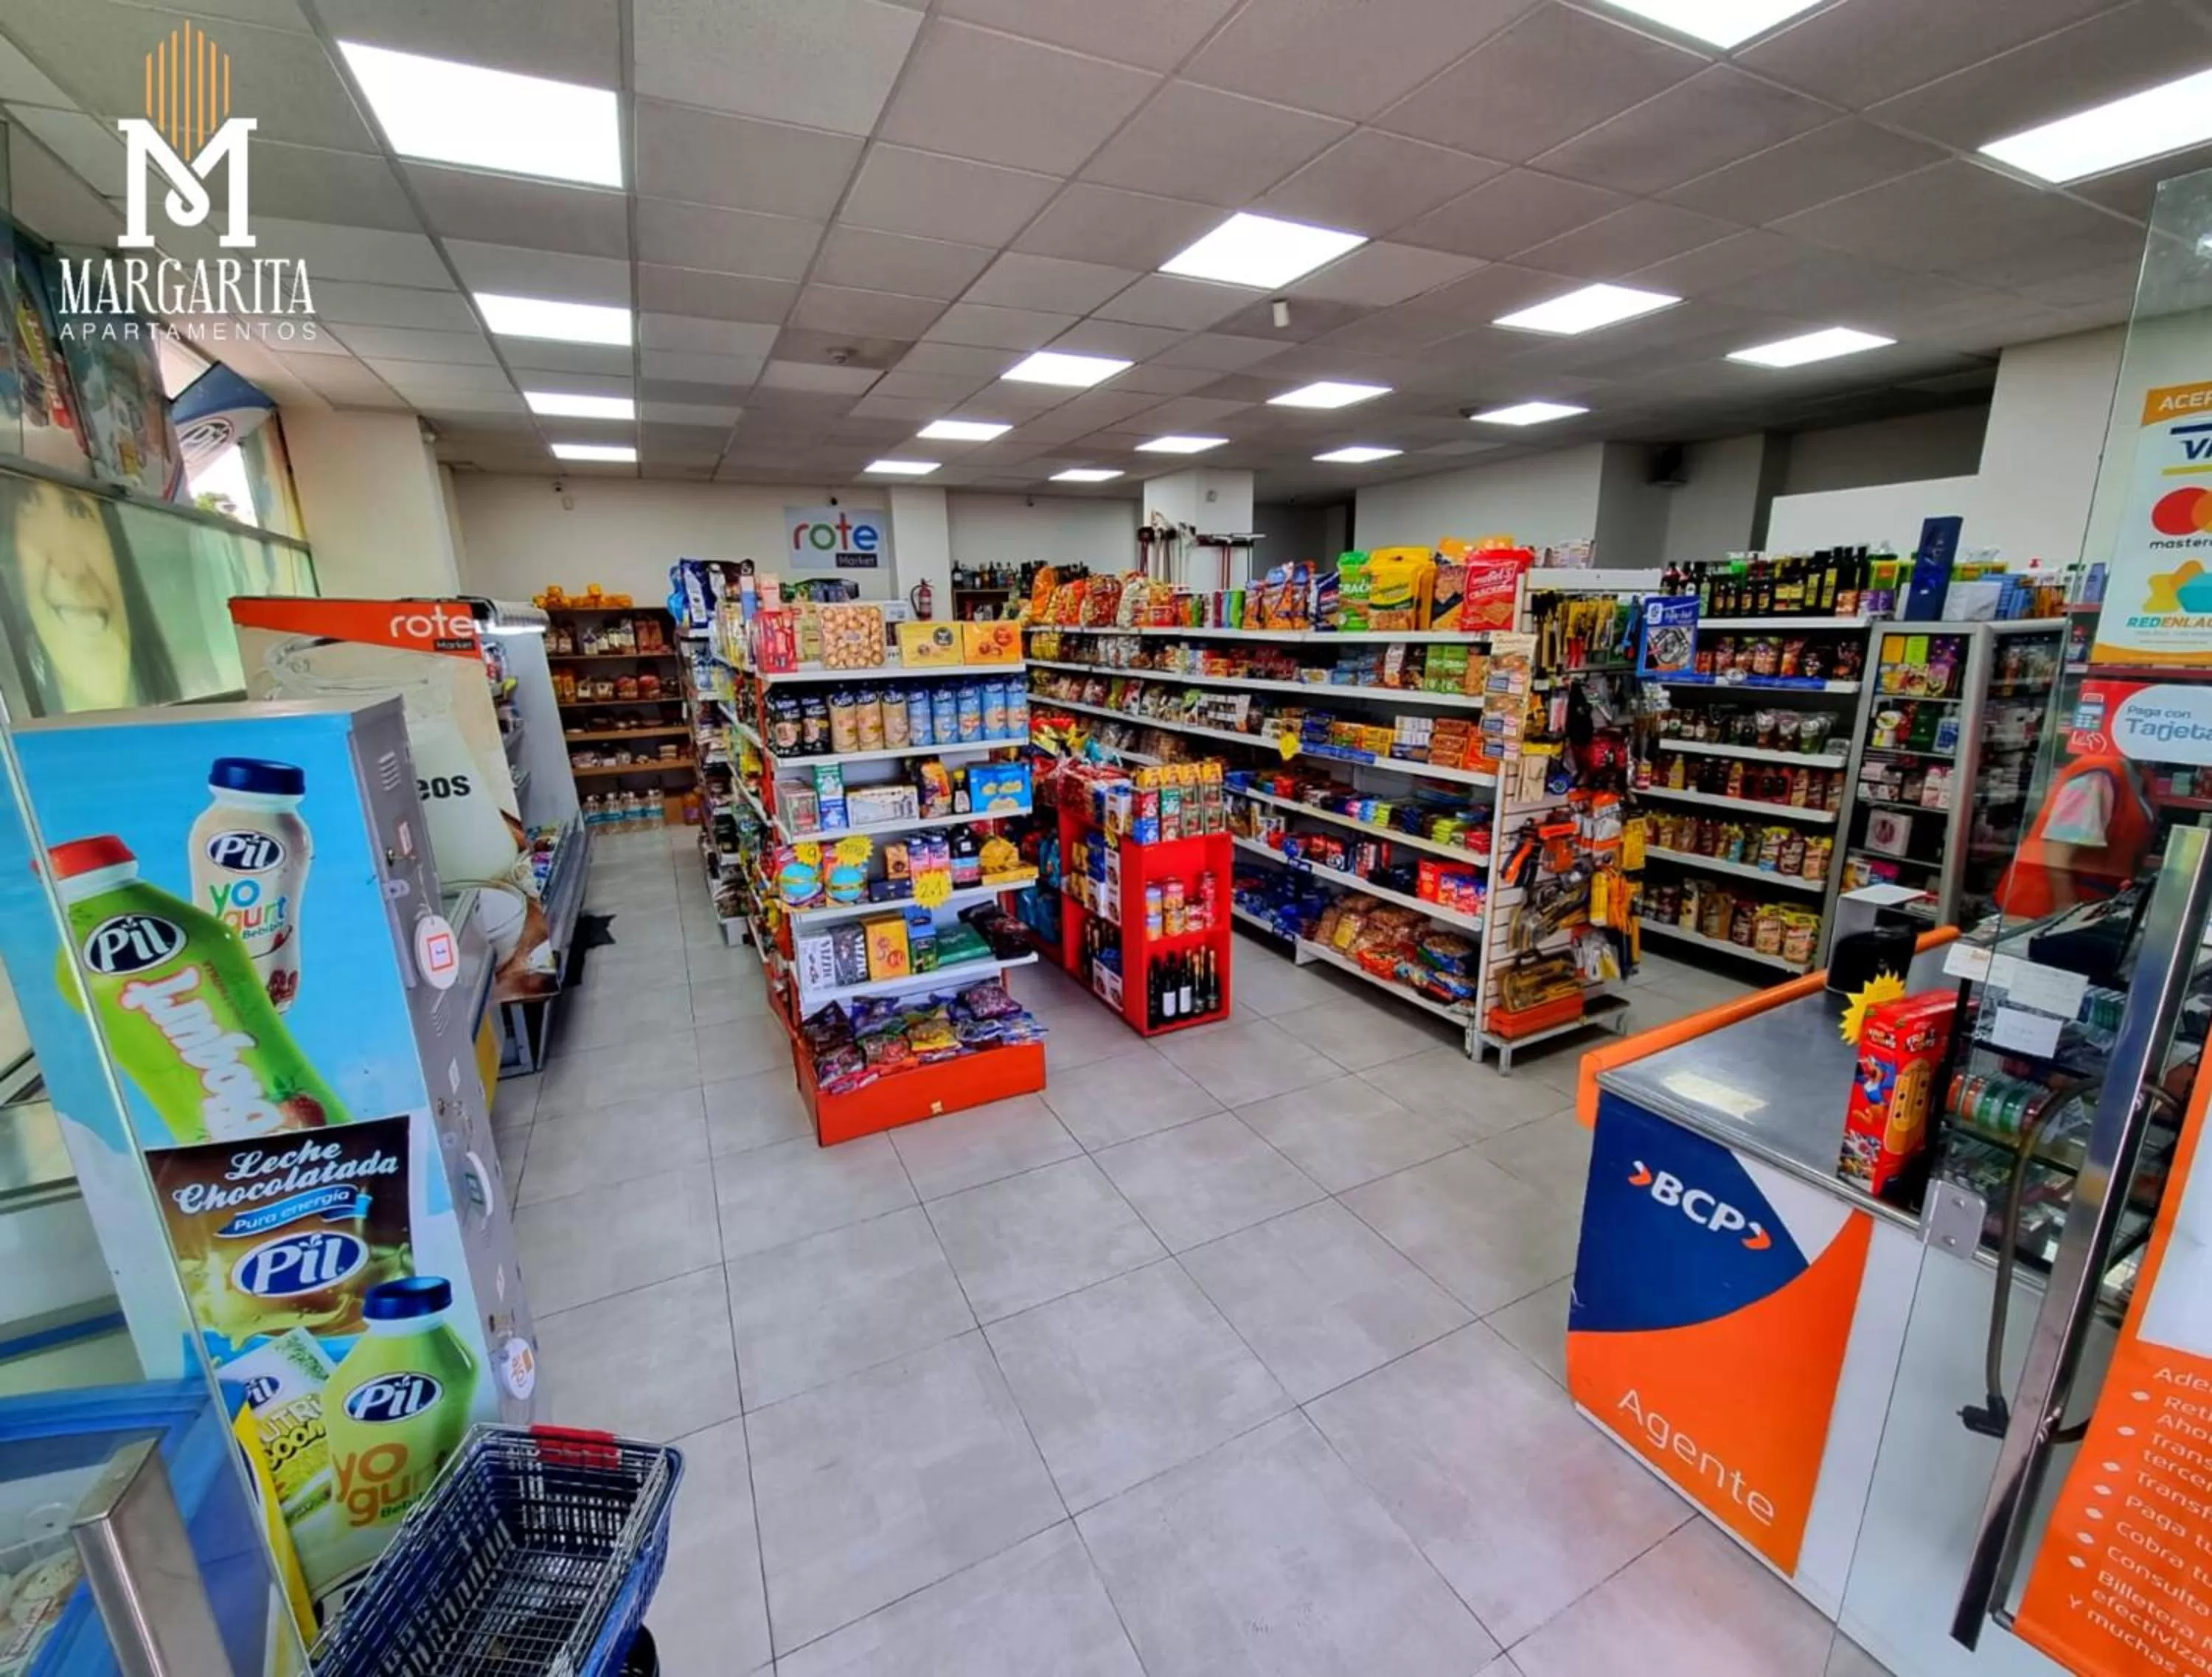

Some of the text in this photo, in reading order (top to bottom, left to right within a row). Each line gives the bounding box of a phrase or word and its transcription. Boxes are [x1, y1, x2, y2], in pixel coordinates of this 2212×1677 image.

[793, 512, 878, 551] rote
[390, 605, 473, 638] rote
[2126, 704, 2192, 719] Paga con
[213, 833, 271, 869] Pil
[97, 917, 171, 972] Pil
[172, 1150, 399, 1215] Chocolatada
[224, 1139, 342, 1181] Leche
[234, 1213, 277, 1231] Pura
[1650, 1170, 1745, 1234] BCP
[251, 1234, 343, 1295] Pil
[353, 1374, 424, 1419] Pil
[2153, 1367, 2212, 1393] Ade
[1618, 1389, 1775, 1527] Agente
[2124, 1494, 2186, 1538] Paga
[2115, 1521, 2185, 1569] Cobra
[2107, 1545, 2211, 1617] Consulta
[2098, 1569, 2195, 1640] Billetera
[2087, 1609, 2177, 1673] muchas
